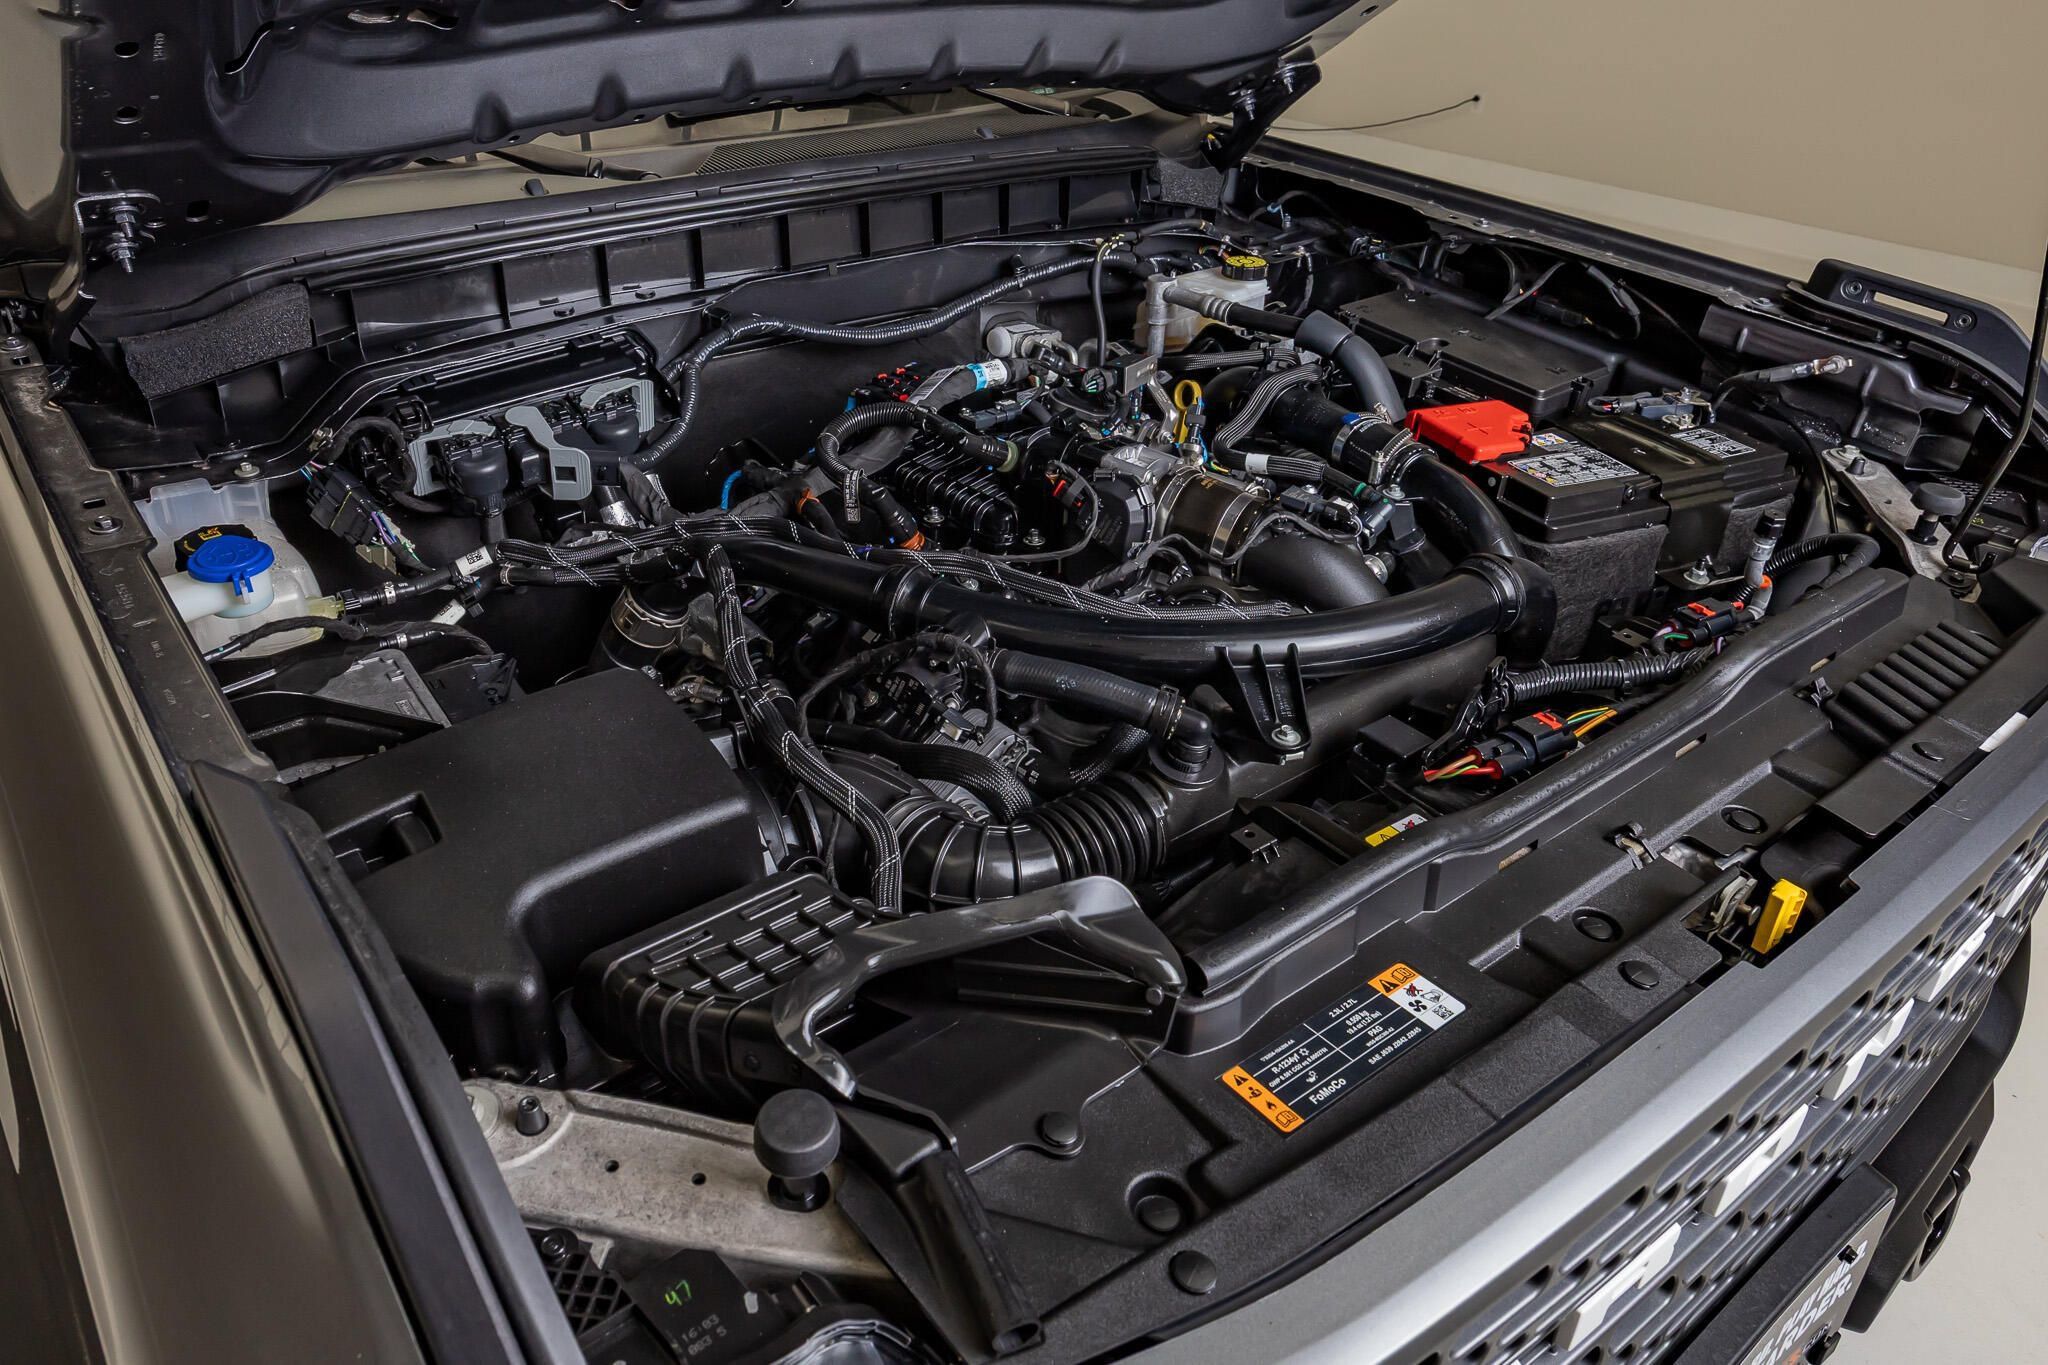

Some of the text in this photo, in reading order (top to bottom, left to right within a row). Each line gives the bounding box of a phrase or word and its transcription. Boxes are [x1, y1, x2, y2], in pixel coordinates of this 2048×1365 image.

[1328, 1005, 1343, 1018] 2.3L
[1344, 998, 1358, 1010] 2.7L
[1360, 1010, 1370, 1018] kg
[1367, 1025, 1383, 1037] PAG
[1271, 1052, 1301, 1074] R-1234yf
[1368, 1054, 1382, 1065] SAE
[1308, 1077, 1347, 1104] FoMoCo
[665, 1280, 692, 1306] 47
[1765, 1274, 1853, 1365] ARDER.
